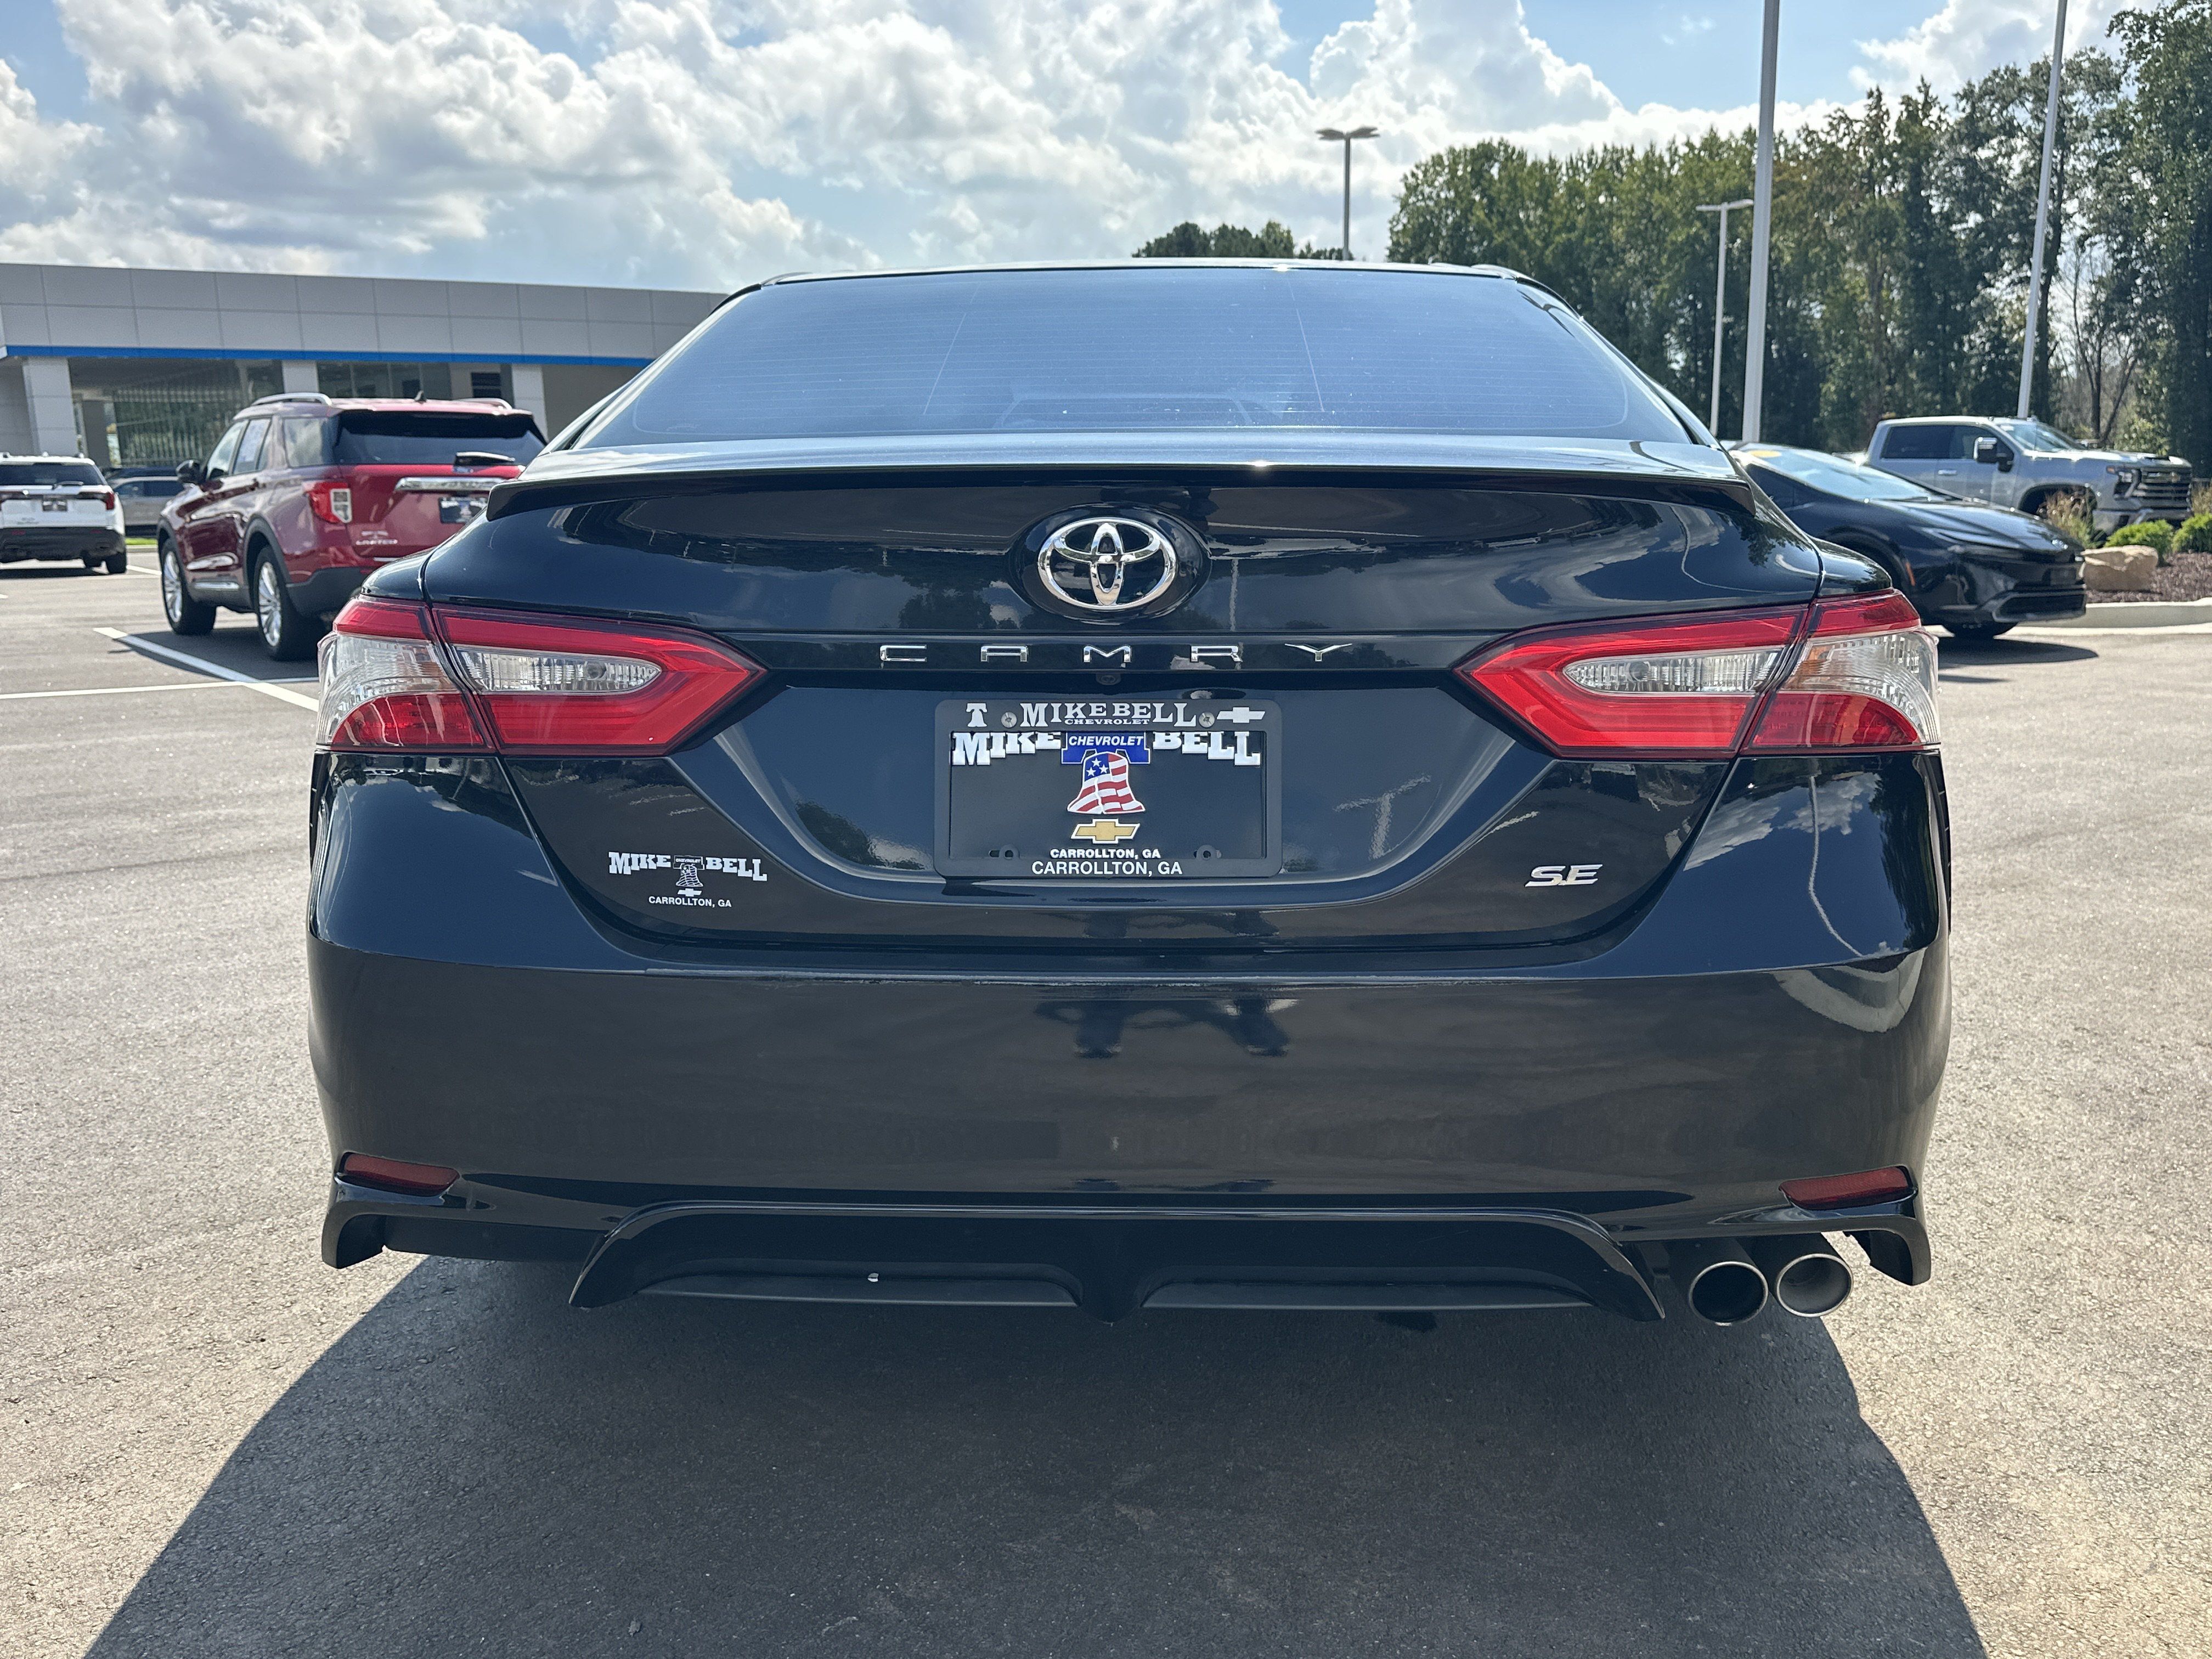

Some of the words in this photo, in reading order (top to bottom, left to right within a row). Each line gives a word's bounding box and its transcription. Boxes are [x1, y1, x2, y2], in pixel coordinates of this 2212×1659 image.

[879, 643, 1352, 663] CAMRY
[1019, 702, 1107, 727] MIKE
[1112, 702, 1197, 727] BELL
[952, 731, 1061, 765] MIKE
[1153, 731, 1261, 766] BELL
[1068, 735, 1144, 746] CHEVROLET
[1049, 848, 1138, 860] CARROLLTON,
[1142, 849, 1161, 859] GA
[608, 851, 672, 875] MIKE
[706, 857, 768, 882] BELL
[1031, 861, 1153, 877] CARROLLTON,
[1157, 861, 1183, 875] GA
[1525, 864, 1603, 887] SE
[648, 895, 715, 908] CARROLLTON,
[718, 899, 732, 908] GA
